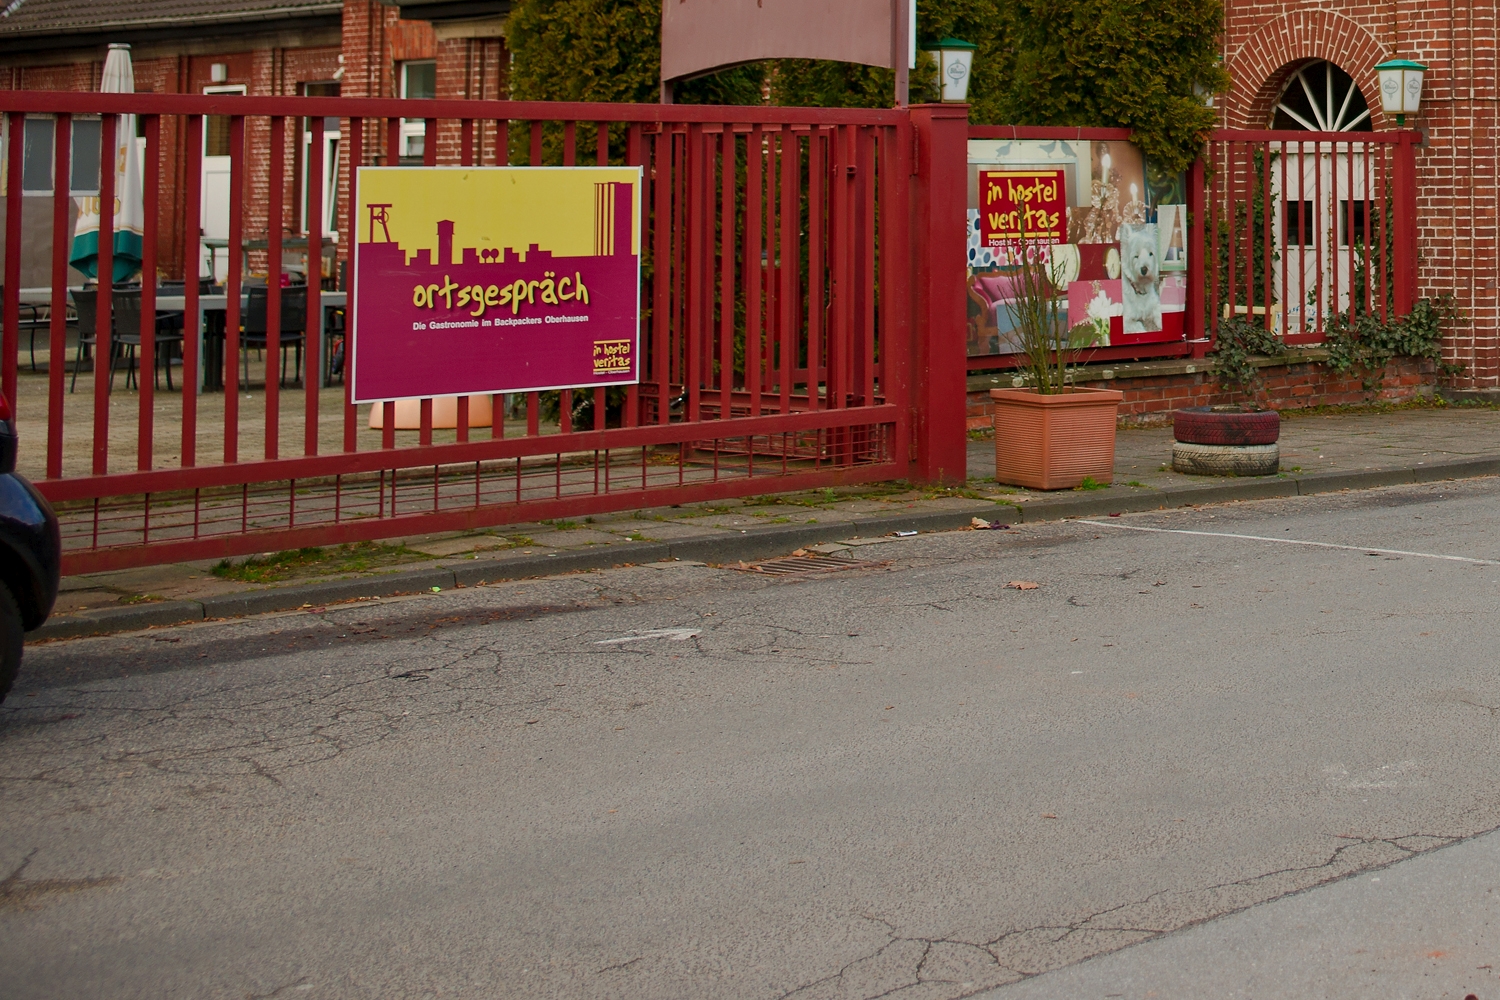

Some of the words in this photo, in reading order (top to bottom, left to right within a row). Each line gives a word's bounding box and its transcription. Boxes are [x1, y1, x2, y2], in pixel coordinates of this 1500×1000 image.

[987, 181, 1003, 206] in
[1007, 177, 1057, 205] hostel
[988, 203, 1060, 231] veritas
[412, 271, 589, 317] ortsgespräch
[413, 321, 427, 331] Die
[429, 318, 479, 330] Gastronomie
[482, 318, 492, 327] im
[494, 316, 542, 327] Backpackers
[545, 314, 589, 325] Oberhausen
[592, 345, 602, 357] in
[604, 342, 630, 355] hostel
[593, 354, 631, 368] veritas
